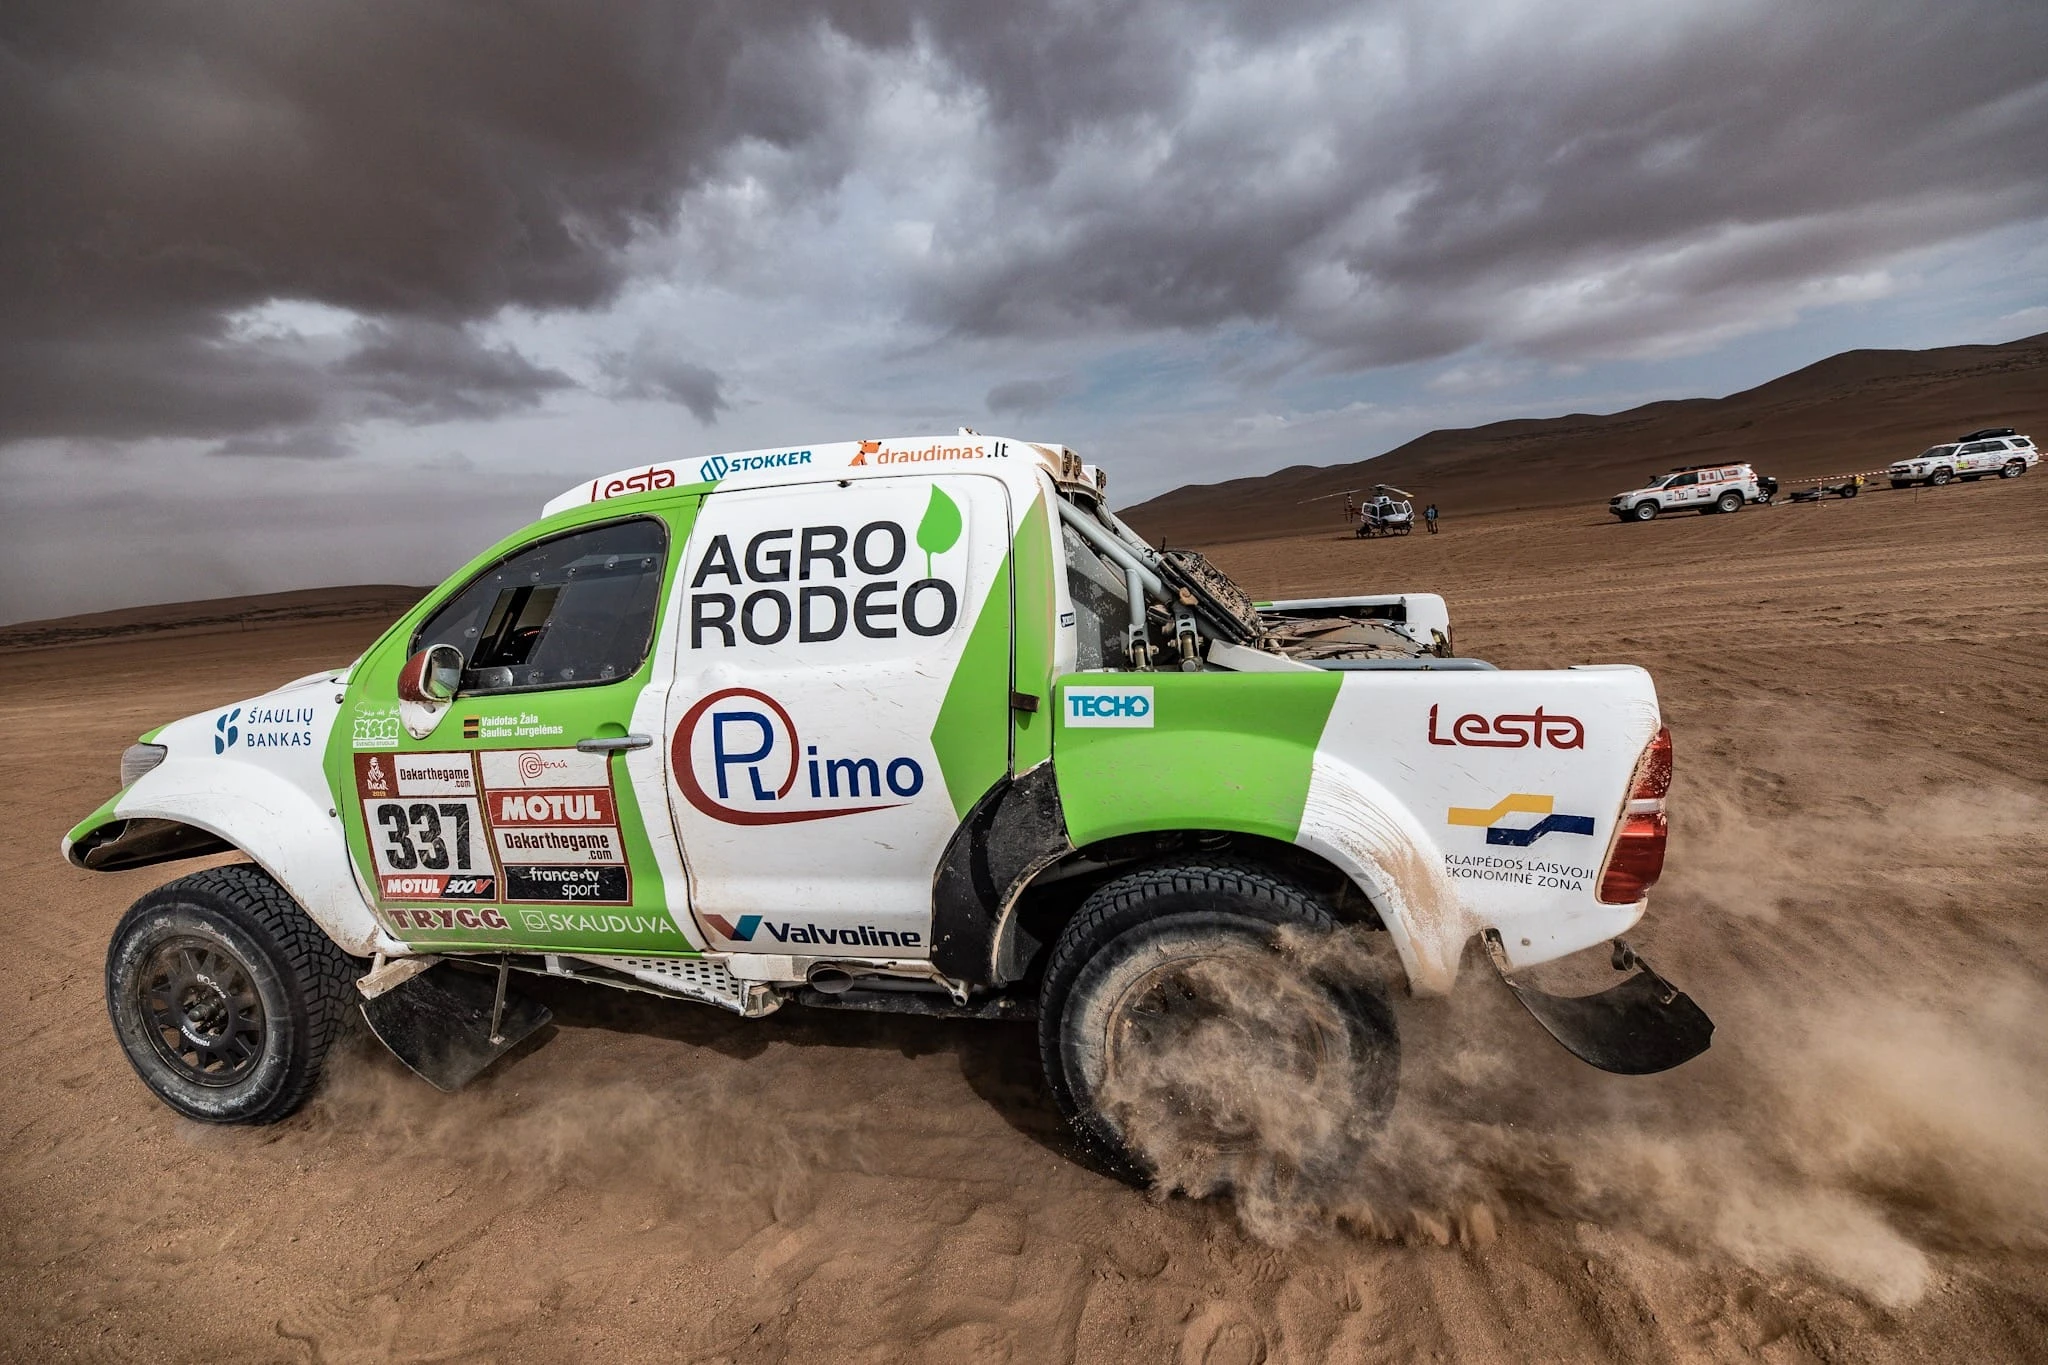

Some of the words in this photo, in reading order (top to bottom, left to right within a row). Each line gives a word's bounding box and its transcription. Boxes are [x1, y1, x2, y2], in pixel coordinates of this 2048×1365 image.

[729, 450, 812, 473] STOKKER
[877, 441, 1009, 465] draudimas.lt
[591, 467, 676, 503] Lesta
[690, 520, 906, 588] AGRO
[690, 578, 958, 650] RODEO
[247, 706, 314, 726] ŠIAULIŲ
[1068, 695, 1150, 717] TECHO
[481, 715, 518, 726] Vaidotas
[519, 712, 539, 725] Žala
[1427, 703, 1585, 750] Lesta
[247, 731, 312, 747] BANKAS
[480, 726, 513, 738] Saulius
[514, 724, 563, 738] Jurgelėnas
[399, 767, 470, 782] Dakarthegame
[454, 780, 471, 788] .com
[501, 794, 602, 822] MOTUL
[377, 803, 473, 871] 337
[504, 832, 609, 852] Dakarthegame
[587, 849, 612, 861] .com
[1444, 853, 1523, 870] KLAIPĖDOS
[1527, 860, 1594, 880] LAISVOJI
[387, 879, 441, 895] MOTUL
[445, 878, 494, 895] 300V
[561, 882, 601, 900] sport
[1537, 875, 1583, 892] ZONA
[387, 907, 513, 931] TRYGG
[549, 913, 677, 935] SKAUDUVA
[763, 921, 922, 948] Valvoline
